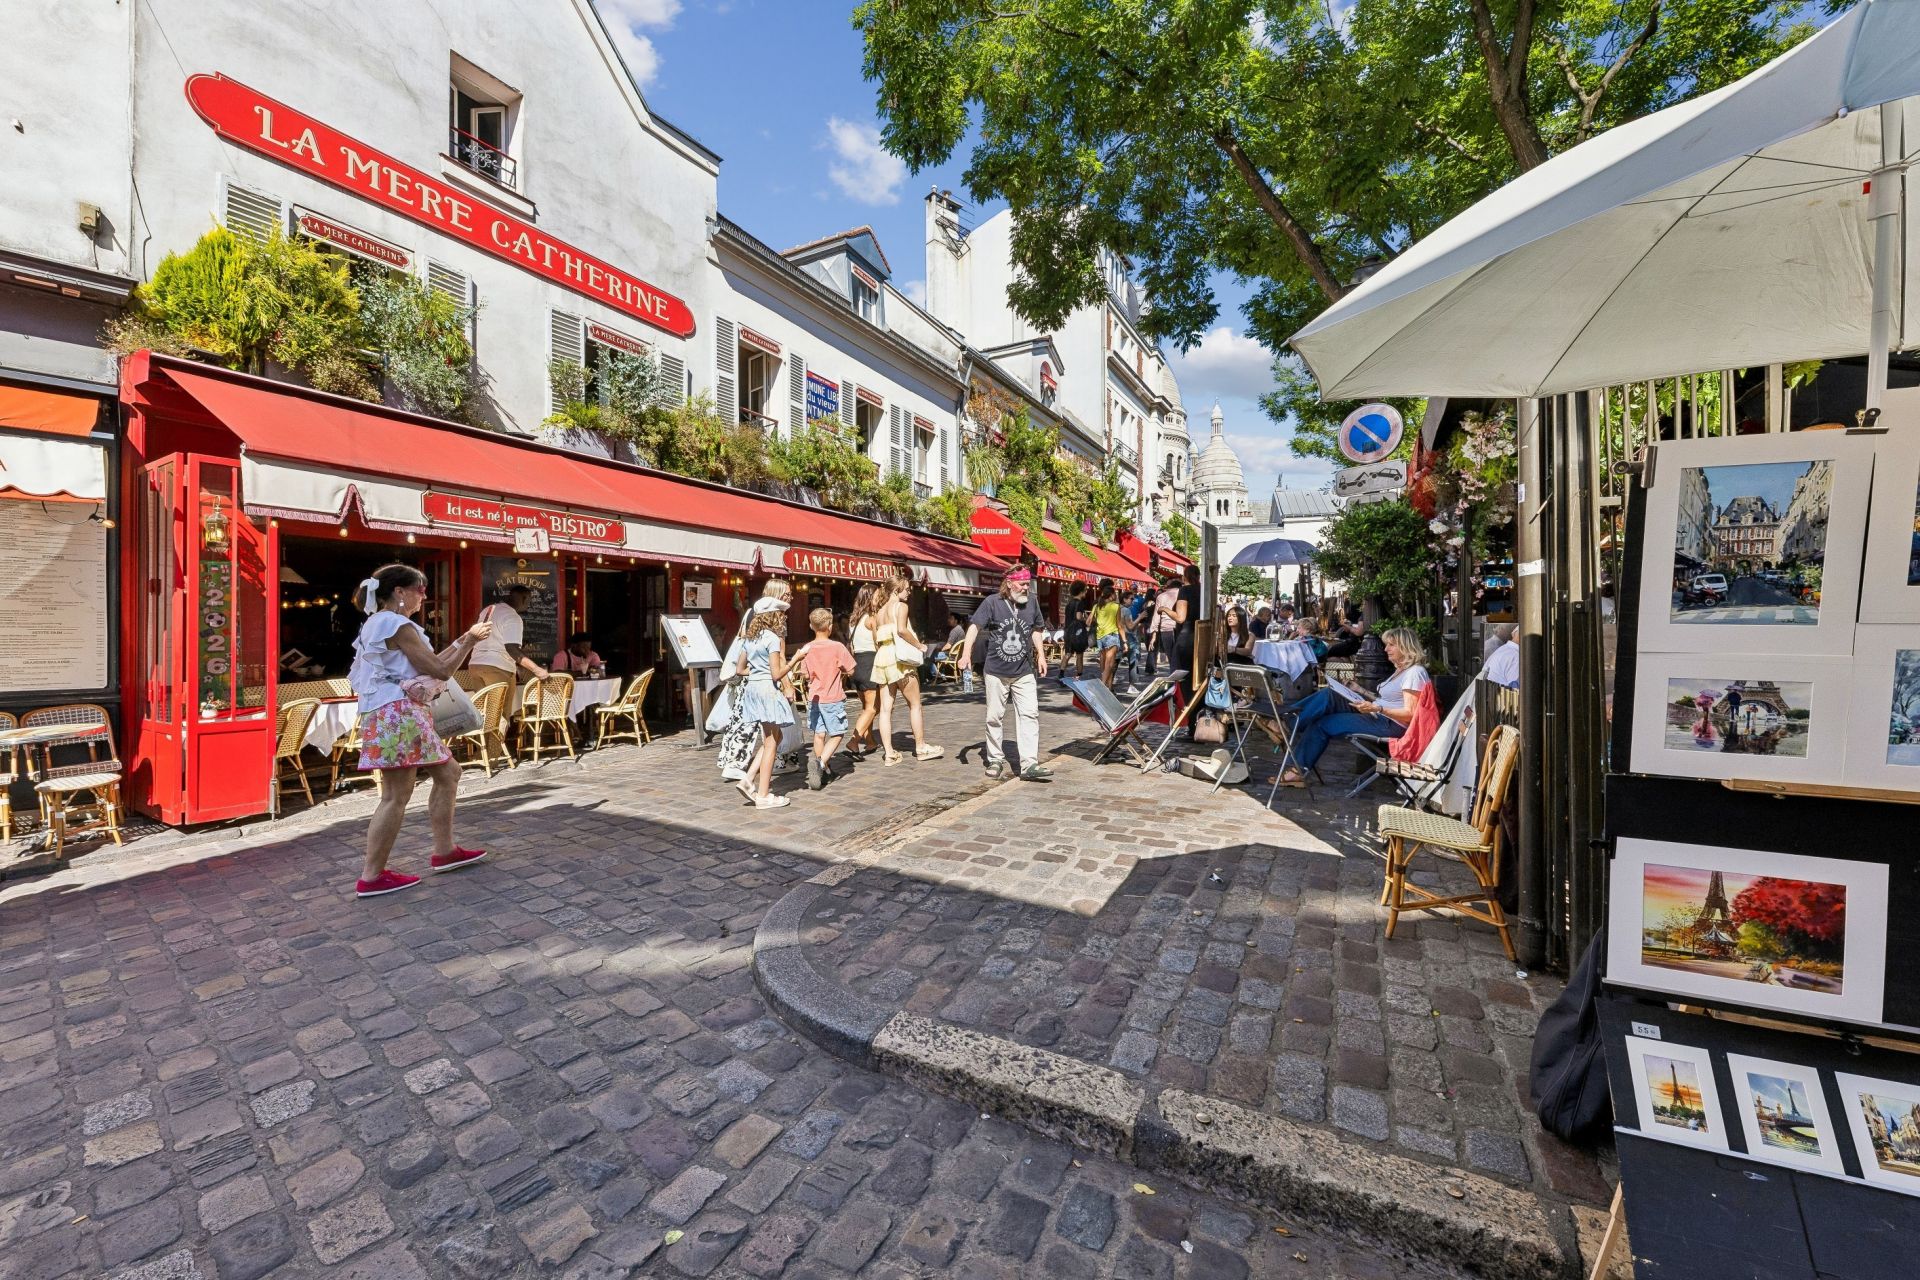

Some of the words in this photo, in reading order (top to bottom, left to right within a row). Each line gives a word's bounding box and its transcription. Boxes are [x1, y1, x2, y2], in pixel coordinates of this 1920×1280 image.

[254, 105, 326, 166] LA
[340, 146, 473, 232] MERE
[490, 220, 670, 321] CATHERINE
[307, 219, 320, 231] LA
[323, 225, 349, 242] MERE
[351, 238, 402, 262] CATHERINE
[807, 391, 816, 402] du
[817, 396, 836, 412] vieux
[447, 502, 461, 516] Ici
[465, 507, 484, 519] est
[487, 508, 501, 520] né
[503, 511, 514, 523] le
[971, 526, 1011, 535] Restaurant
[793, 552, 811, 571] LA
[812, 555, 846, 576] MERE
[848, 560, 905, 580] CATHERINE
[998, 617, 1030, 635] NASHILLE
